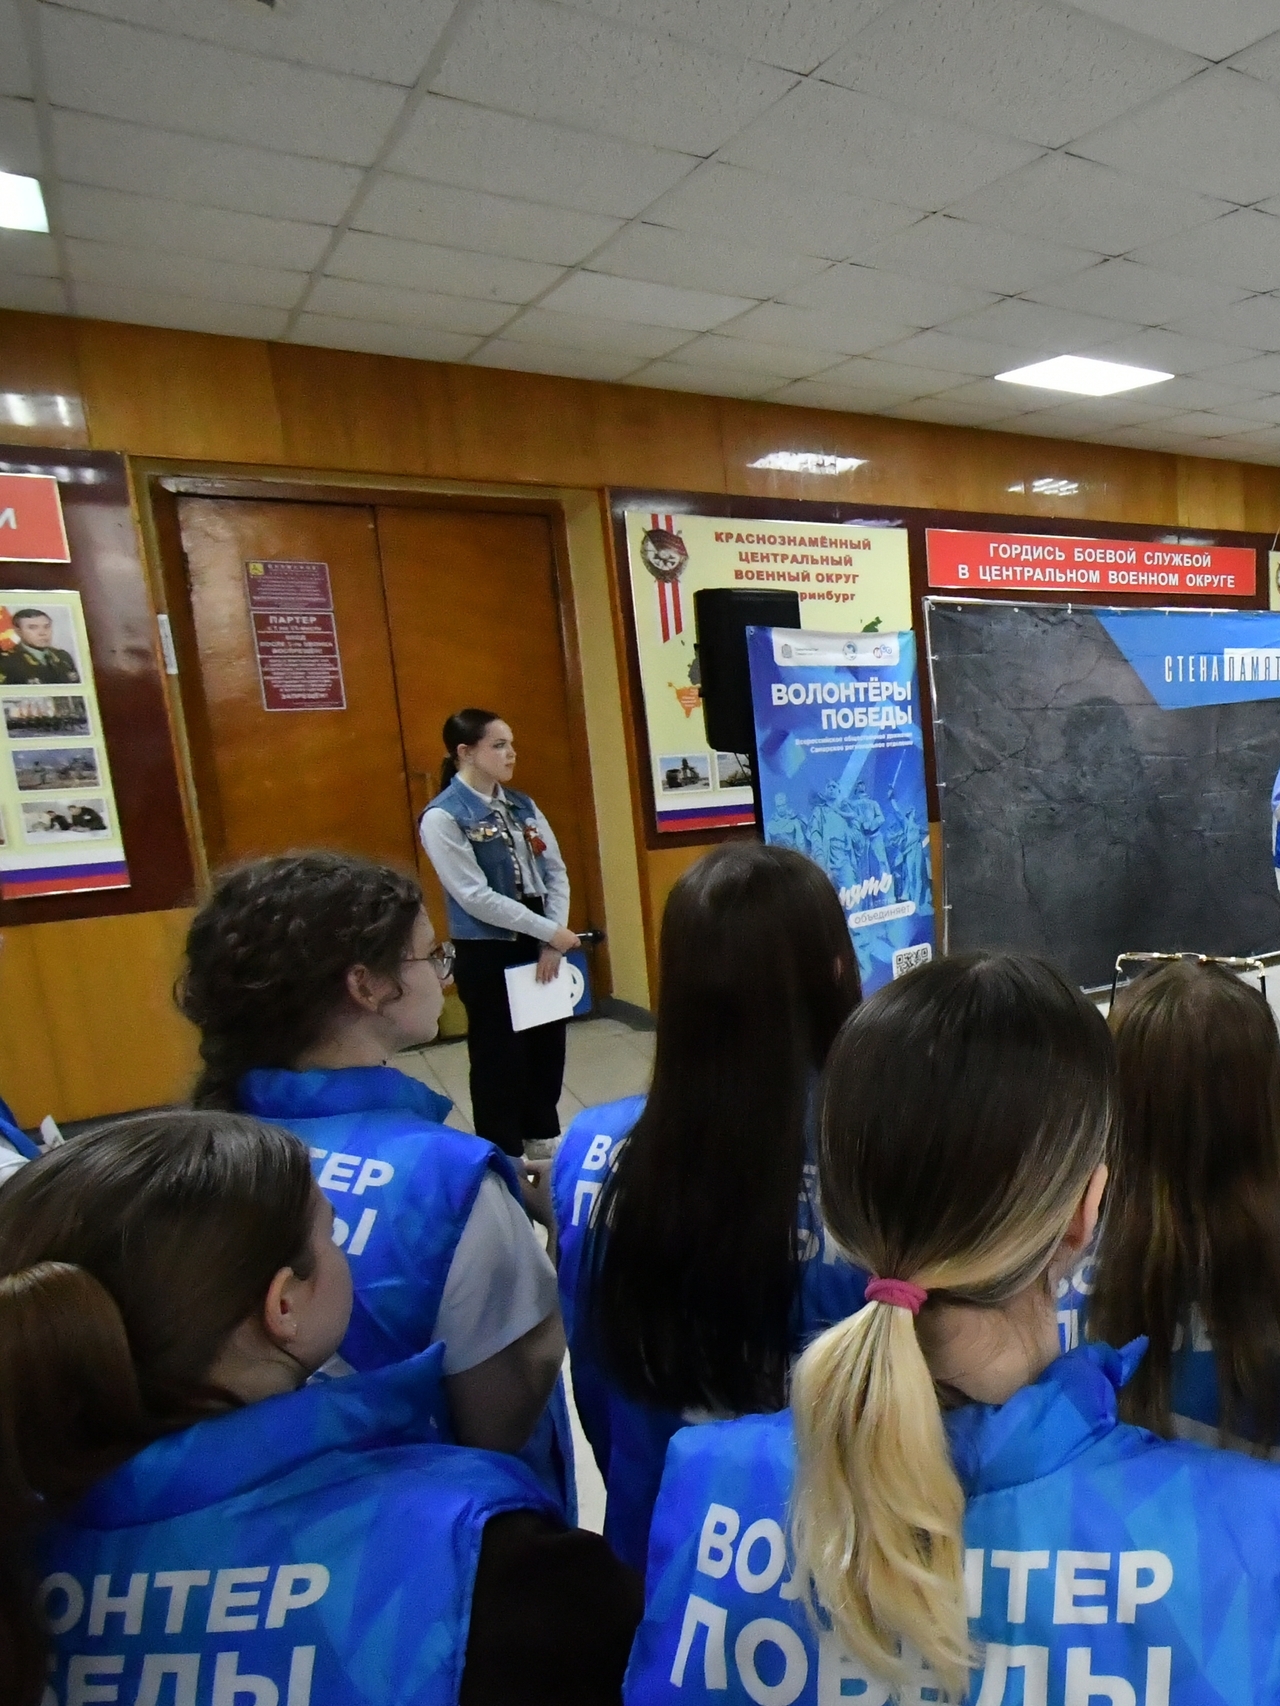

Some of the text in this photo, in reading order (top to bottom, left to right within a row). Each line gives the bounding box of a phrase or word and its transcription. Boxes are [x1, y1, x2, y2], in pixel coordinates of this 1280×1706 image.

[714, 531, 872, 550] КРАСНОЗНАМЁННЫЙ
[738, 551, 853, 566] ЦЕНТРАЛЬНЫЙ
[989, 543, 1211, 567] ГОРДИСЬ БОЕВОЙ СЛУЖБОЙ
[734, 569, 859, 584] ВОЕННЫЙ ОКРУГ
[958, 565, 1235, 588] В ЦЕНТРАЛЬНОМ ВОЕННОМ ОКРУГЕ
[800, 591, 856, 603] ринбург
[269, 616, 317, 624] ПАРТЕР
[1164, 655, 1219, 683] СТЕНА
[771, 676, 912, 706] ВОЛОНТЁРЫ
[821, 705, 913, 730] ПОБЕДЫ
[854, 905, 911, 924] объединяет
[697, 1503, 1174, 1625] ВОТЕР
[37, 1563, 331, 1636] ОНТЕР
